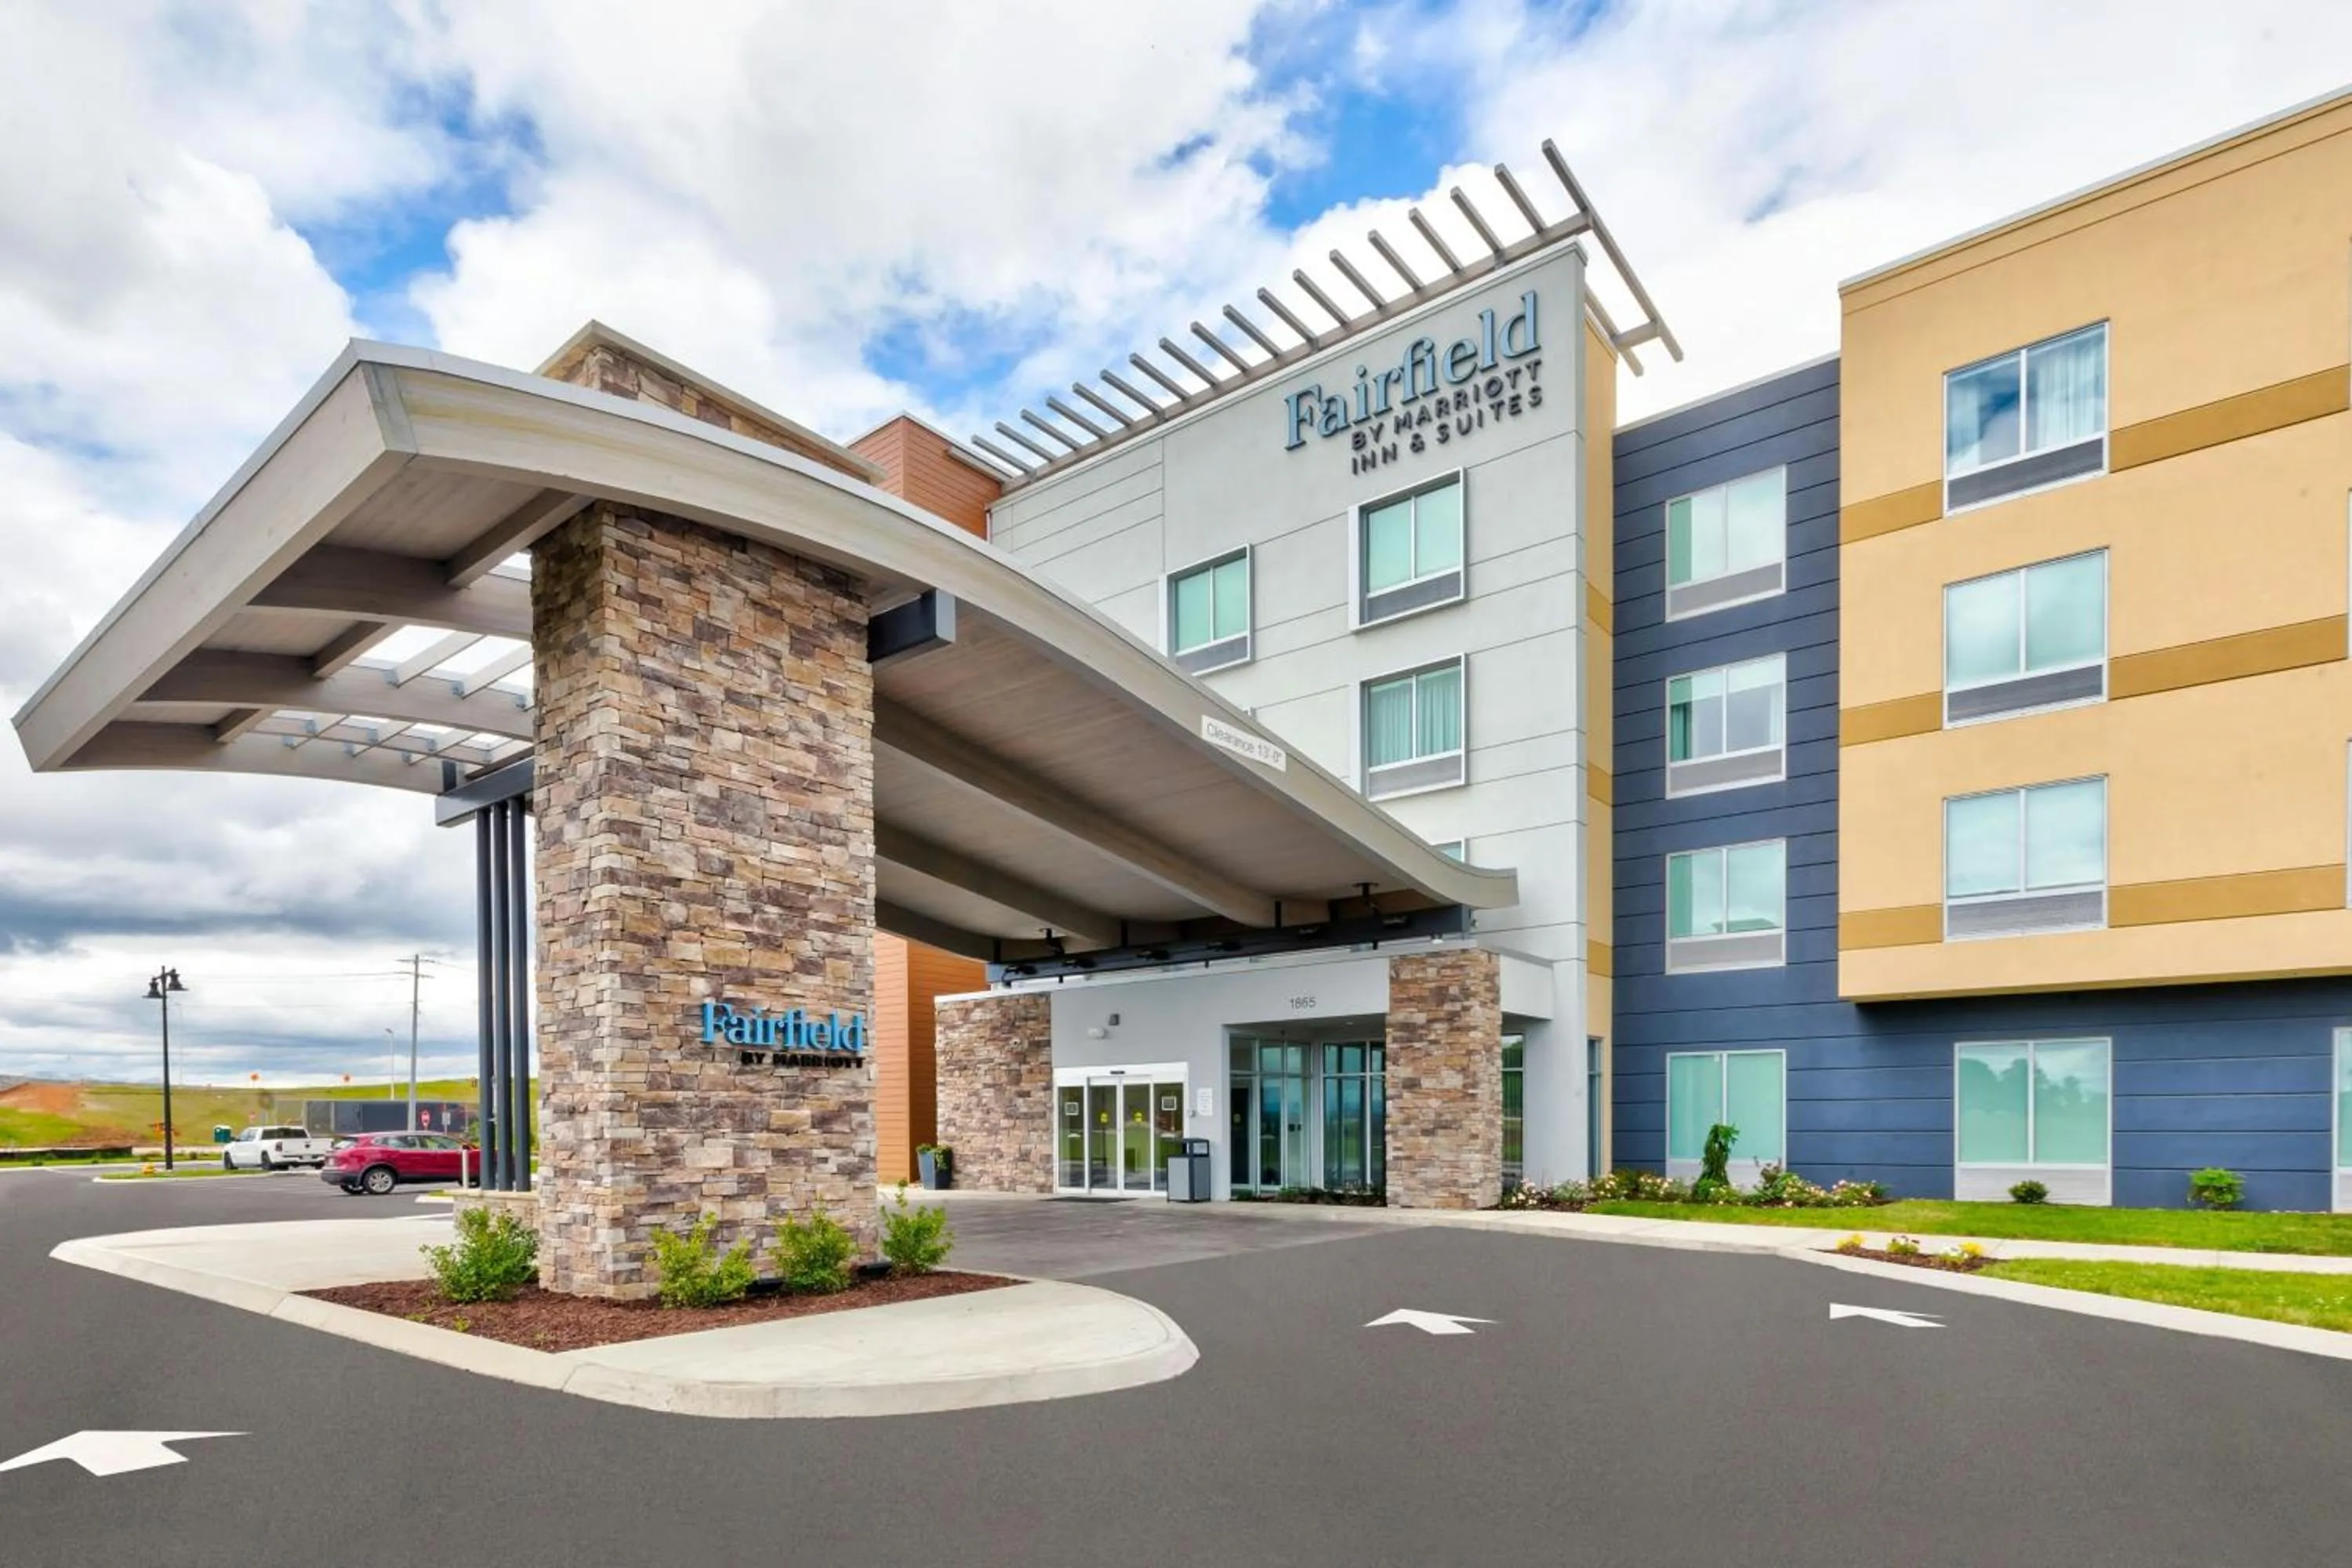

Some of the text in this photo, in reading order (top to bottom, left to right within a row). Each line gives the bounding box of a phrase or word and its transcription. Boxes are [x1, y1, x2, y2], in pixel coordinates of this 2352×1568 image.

[1284, 289, 1541, 451] Fairfield
[1352, 358, 1542, 452] BY MARRIOTT
[1352, 385, 1543, 475] INN & SUITES
[701, 1002, 865, 1053] Fairfield
[741, 1051, 866, 1068] BY MARRIOTT
